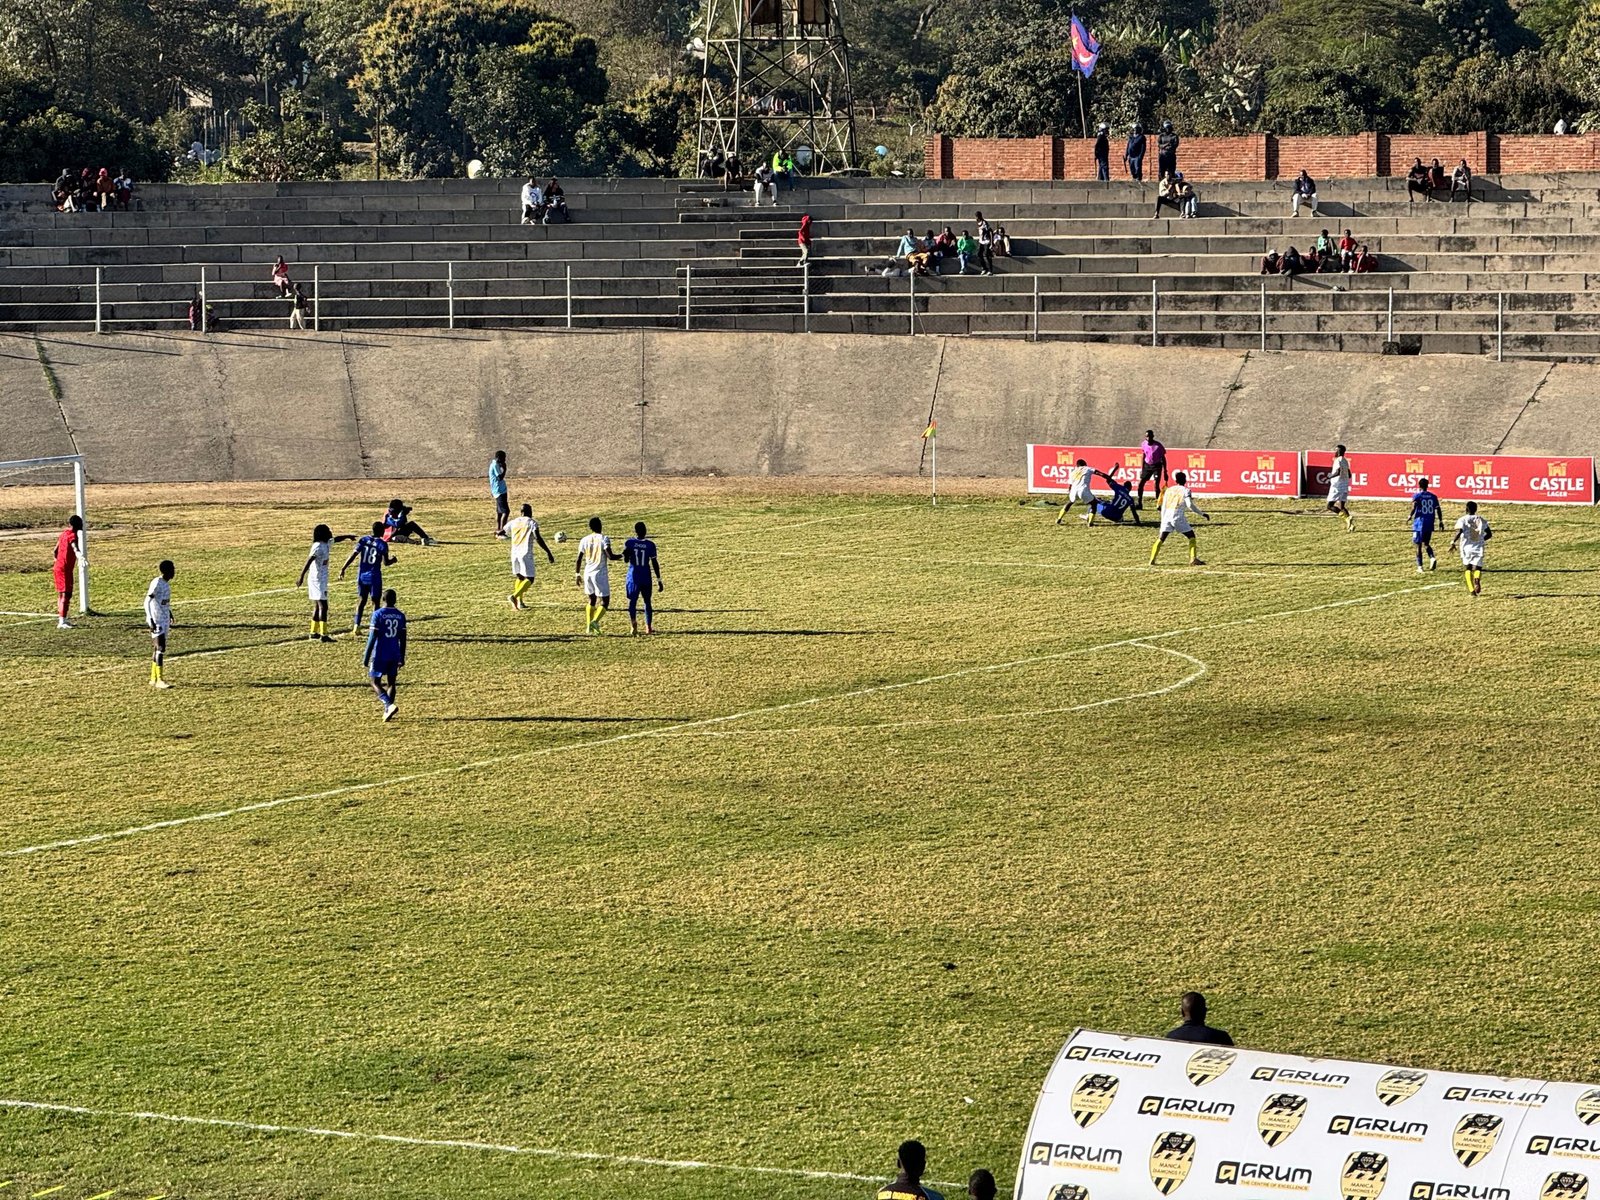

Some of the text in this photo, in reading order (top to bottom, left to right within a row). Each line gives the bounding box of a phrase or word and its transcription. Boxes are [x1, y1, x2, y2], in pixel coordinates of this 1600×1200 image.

[1041, 464, 1076, 479] CAST
[1240, 470, 1291, 484] CASTLE
[1315, 472, 1368, 486] CLE
[1455, 475, 1510, 490] CASTLE
[1529, 477, 1585, 491] CASTLE
[1113, 494, 1128, 510] 19
[1420, 499, 1434, 514] 88
[362, 545, 377, 564] 18
[633, 549, 645, 566] 11
[384, 618, 399, 638] 33
